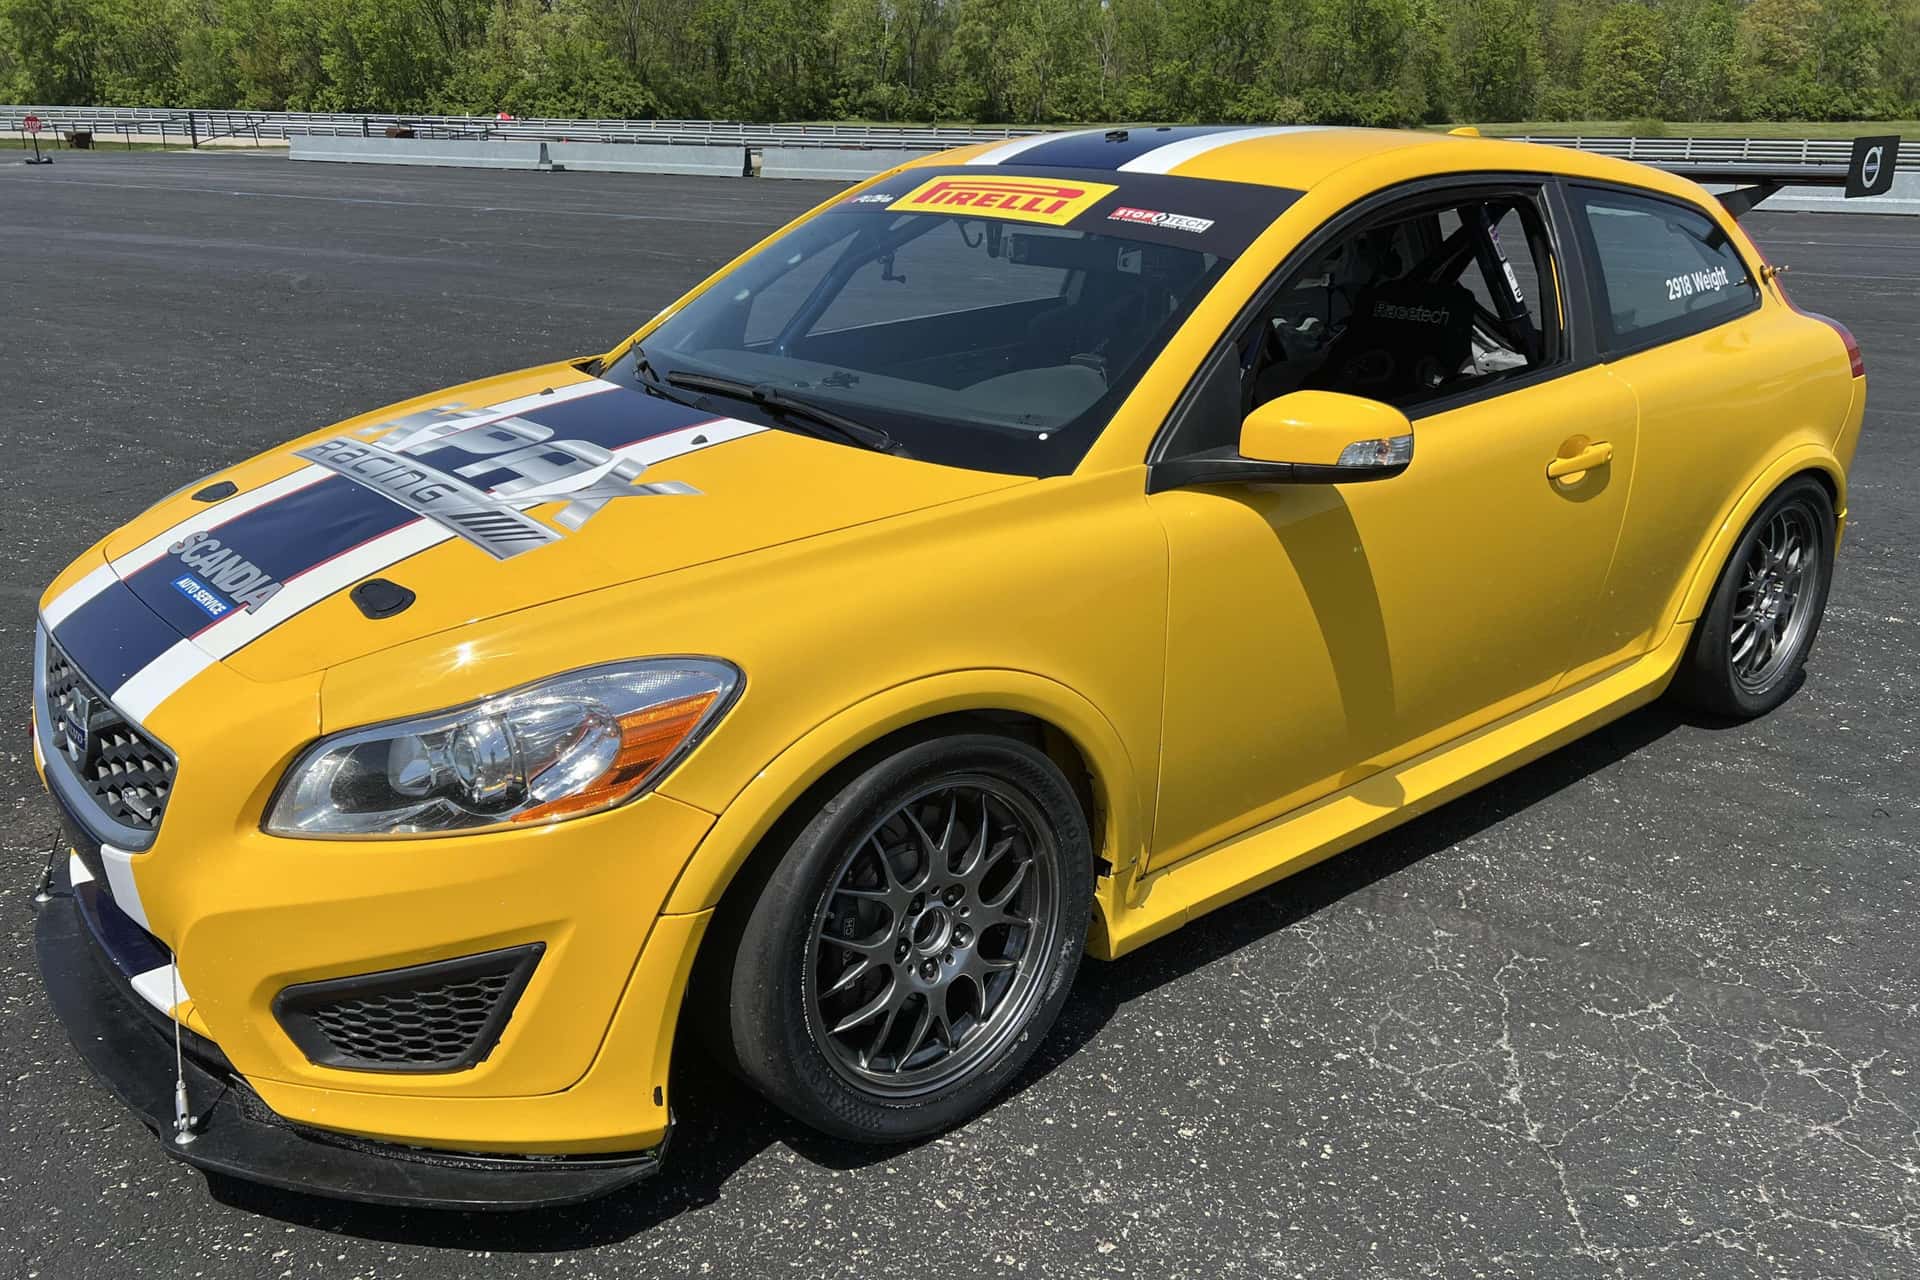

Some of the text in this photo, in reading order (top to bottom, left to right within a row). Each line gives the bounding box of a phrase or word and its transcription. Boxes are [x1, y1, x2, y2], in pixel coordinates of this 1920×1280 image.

[912, 181, 1086, 215] PIRELLI
[1666, 266, 1729, 300] 2918 Weight
[168, 531, 284, 615] SCANDIA
[176, 578, 227, 615] AUTO SERVICE
